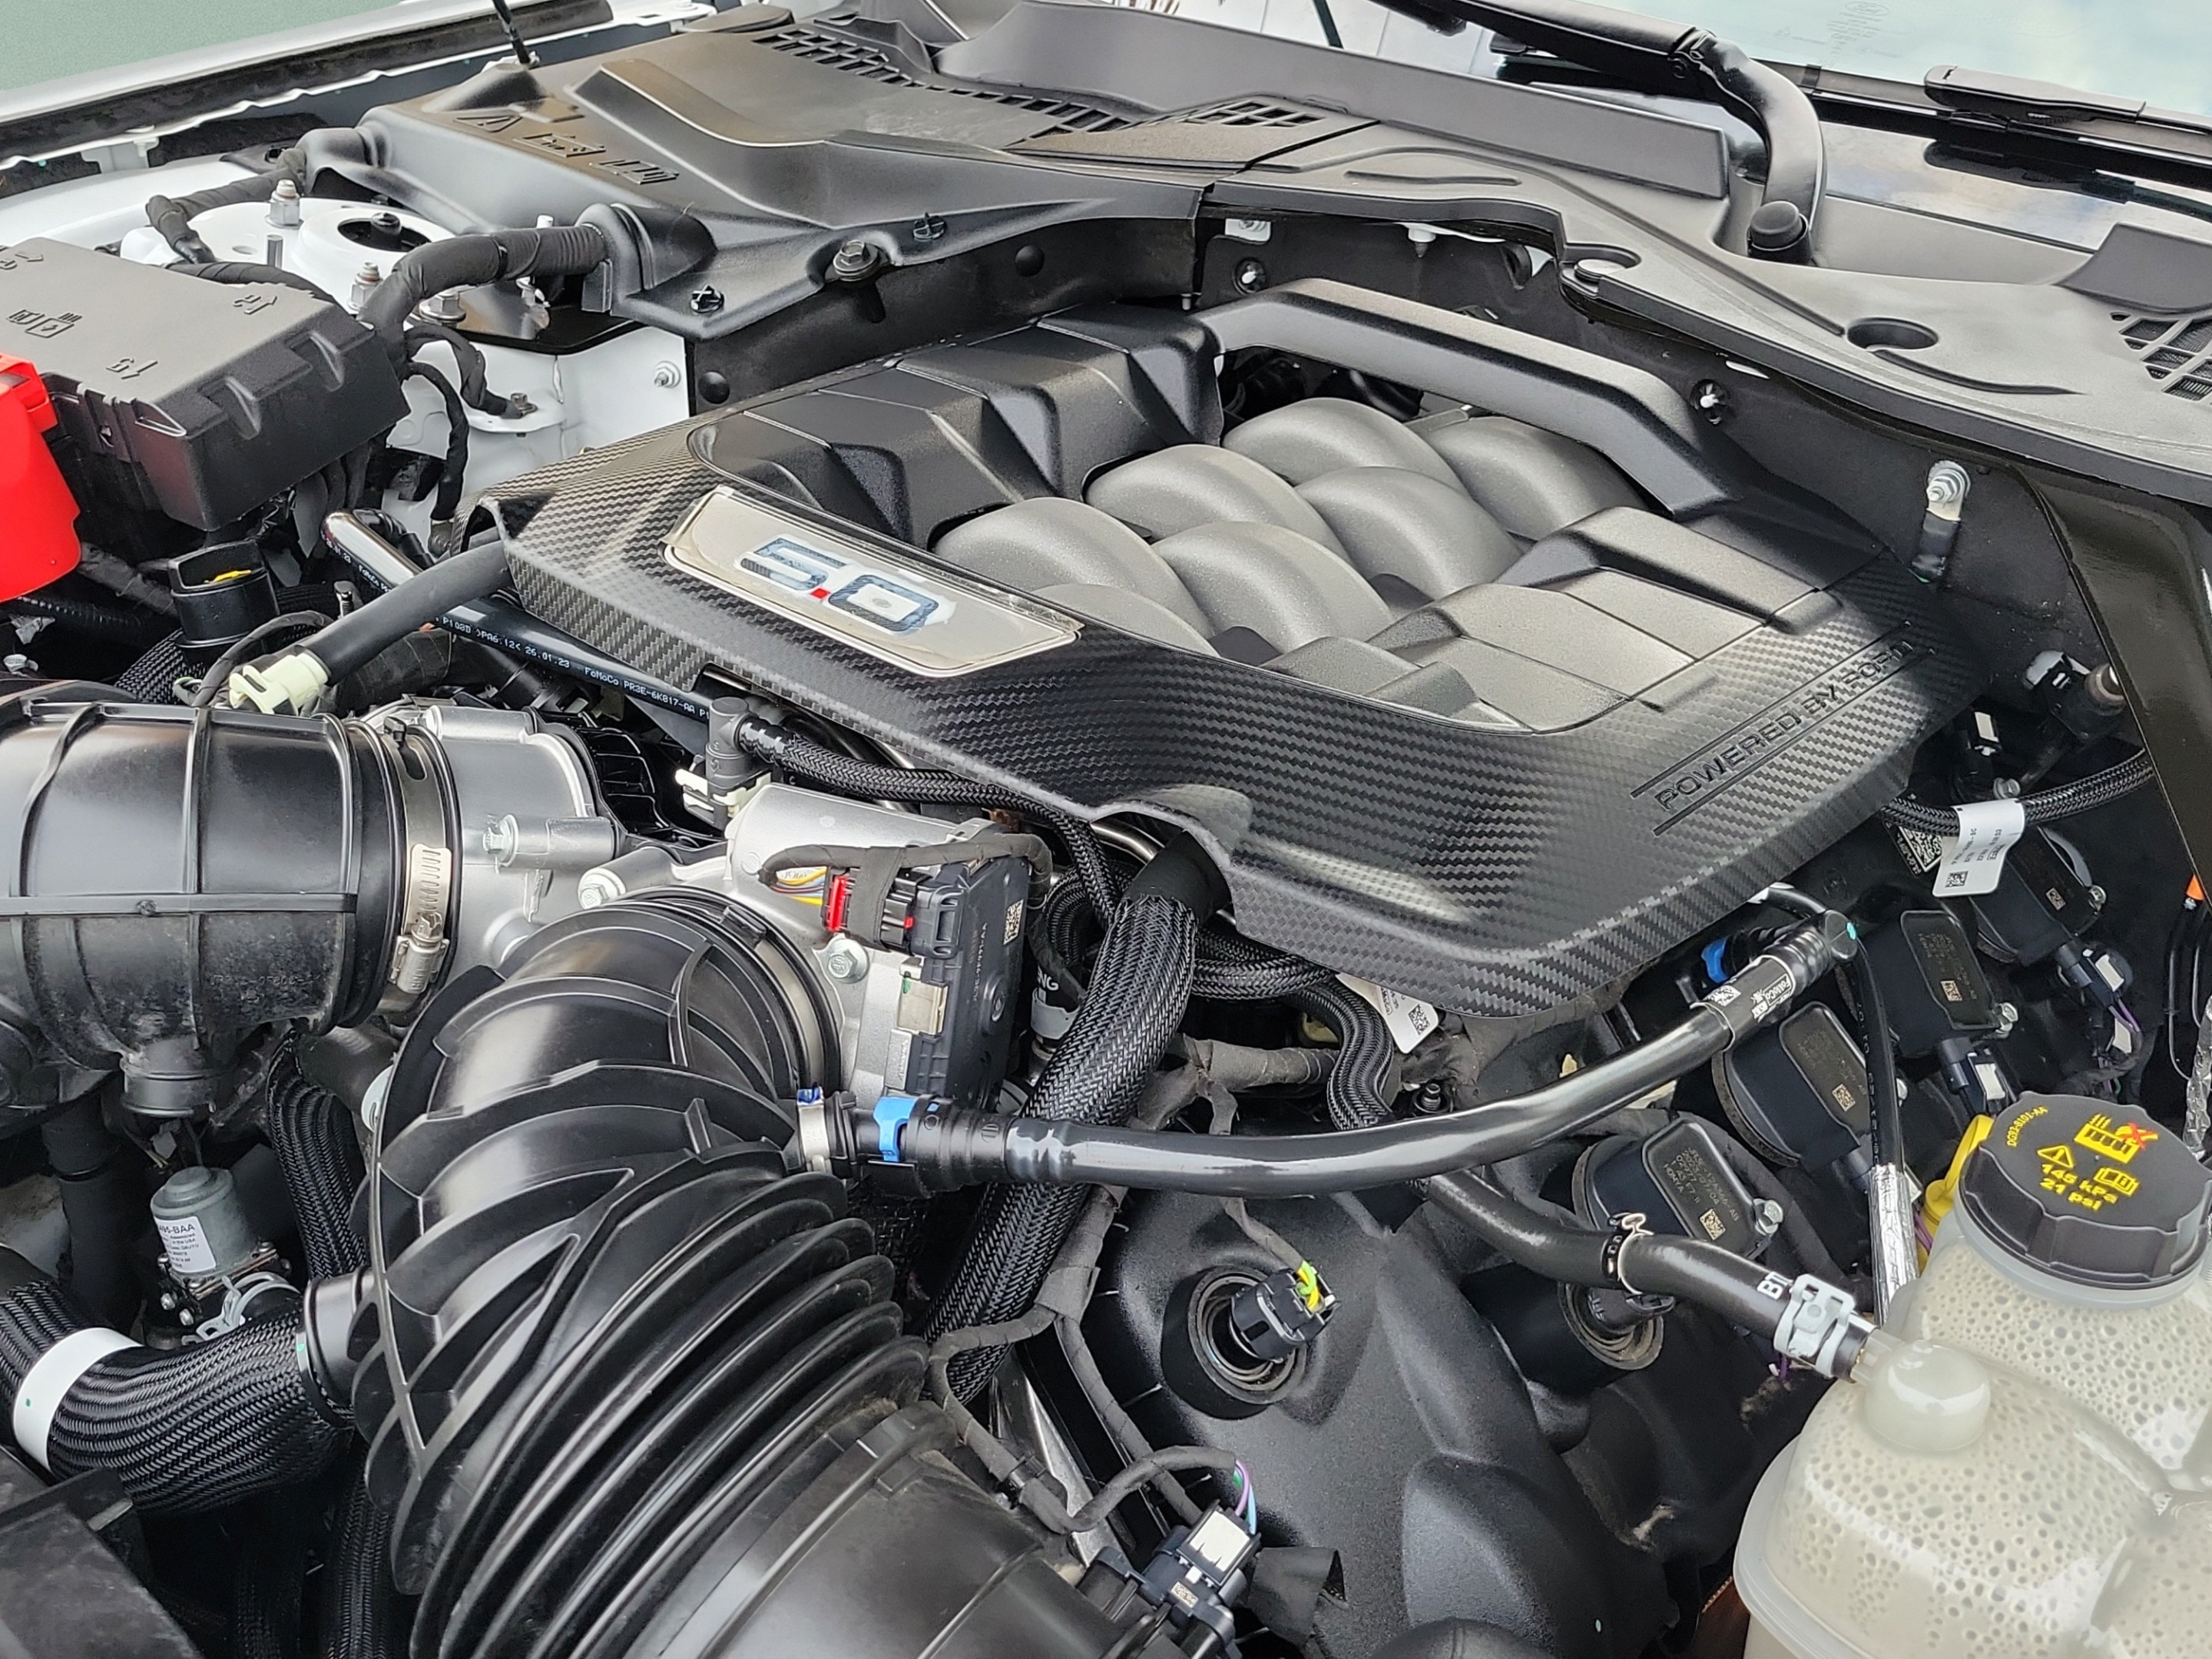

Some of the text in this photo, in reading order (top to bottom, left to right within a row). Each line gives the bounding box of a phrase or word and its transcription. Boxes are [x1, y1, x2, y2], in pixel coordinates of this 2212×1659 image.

[740, 537, 939, 632] 5.0
[525, 646, 571, 668] 26.01.23
[584, 666, 619, 686] FoMoCo
[1654, 639, 1914, 812] POWERED BY FORD
[2040, 1177, 2103, 1211] 21 psi
[2041, 1164, 2119, 1204] 145 kPa
